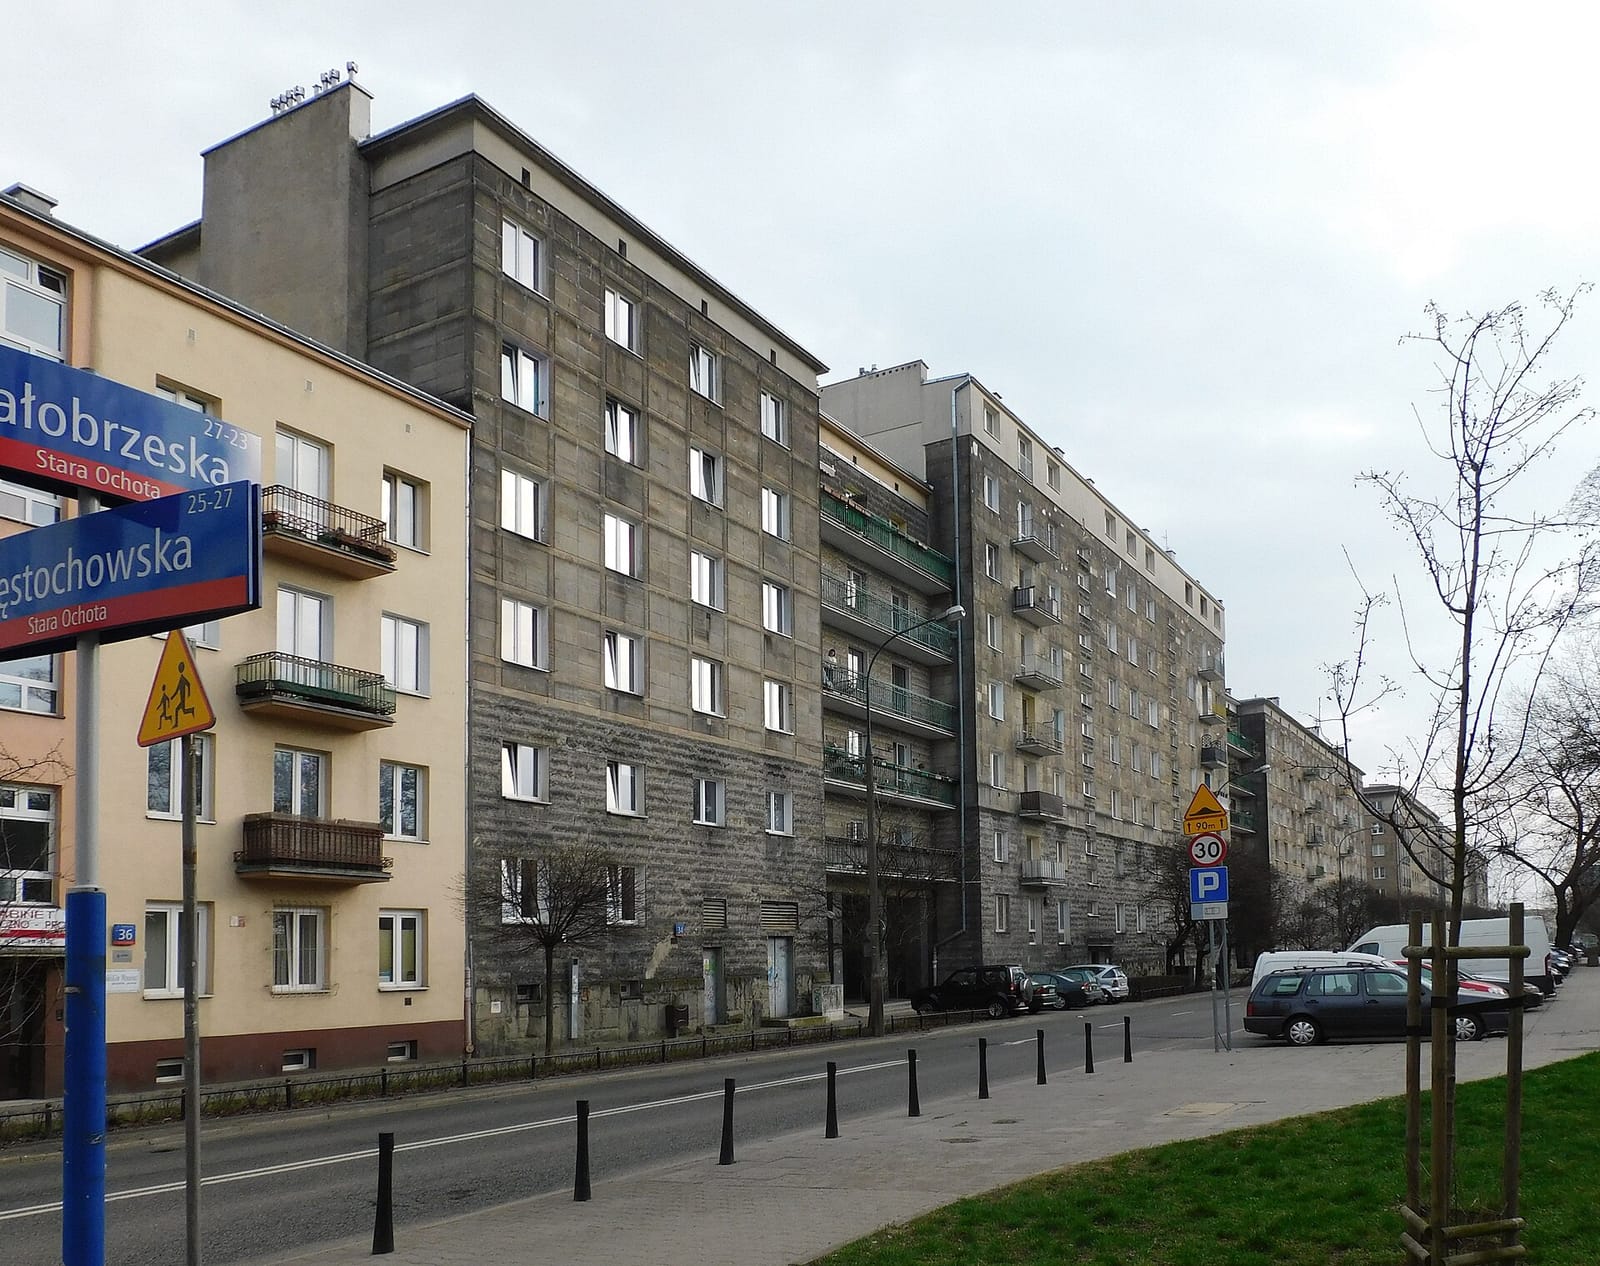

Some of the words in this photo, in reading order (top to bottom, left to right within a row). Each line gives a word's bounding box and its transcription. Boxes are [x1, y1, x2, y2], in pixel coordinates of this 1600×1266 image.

[0, 382, 229, 487] ałobrzeska
[204, 418, 248, 450] 27-23
[36, 449, 88, 480] Stara
[95, 466, 162, 499] Ochota
[187, 488, 233, 514] 25-27
[28, 614, 58, 635] Stara
[62, 605, 107, 628] Ochota
[1196, 822, 1216, 830] 90m
[1194, 842, 1220, 858] 30
[1199, 872, 1219, 898] P
[118, 928, 133, 940] 36
